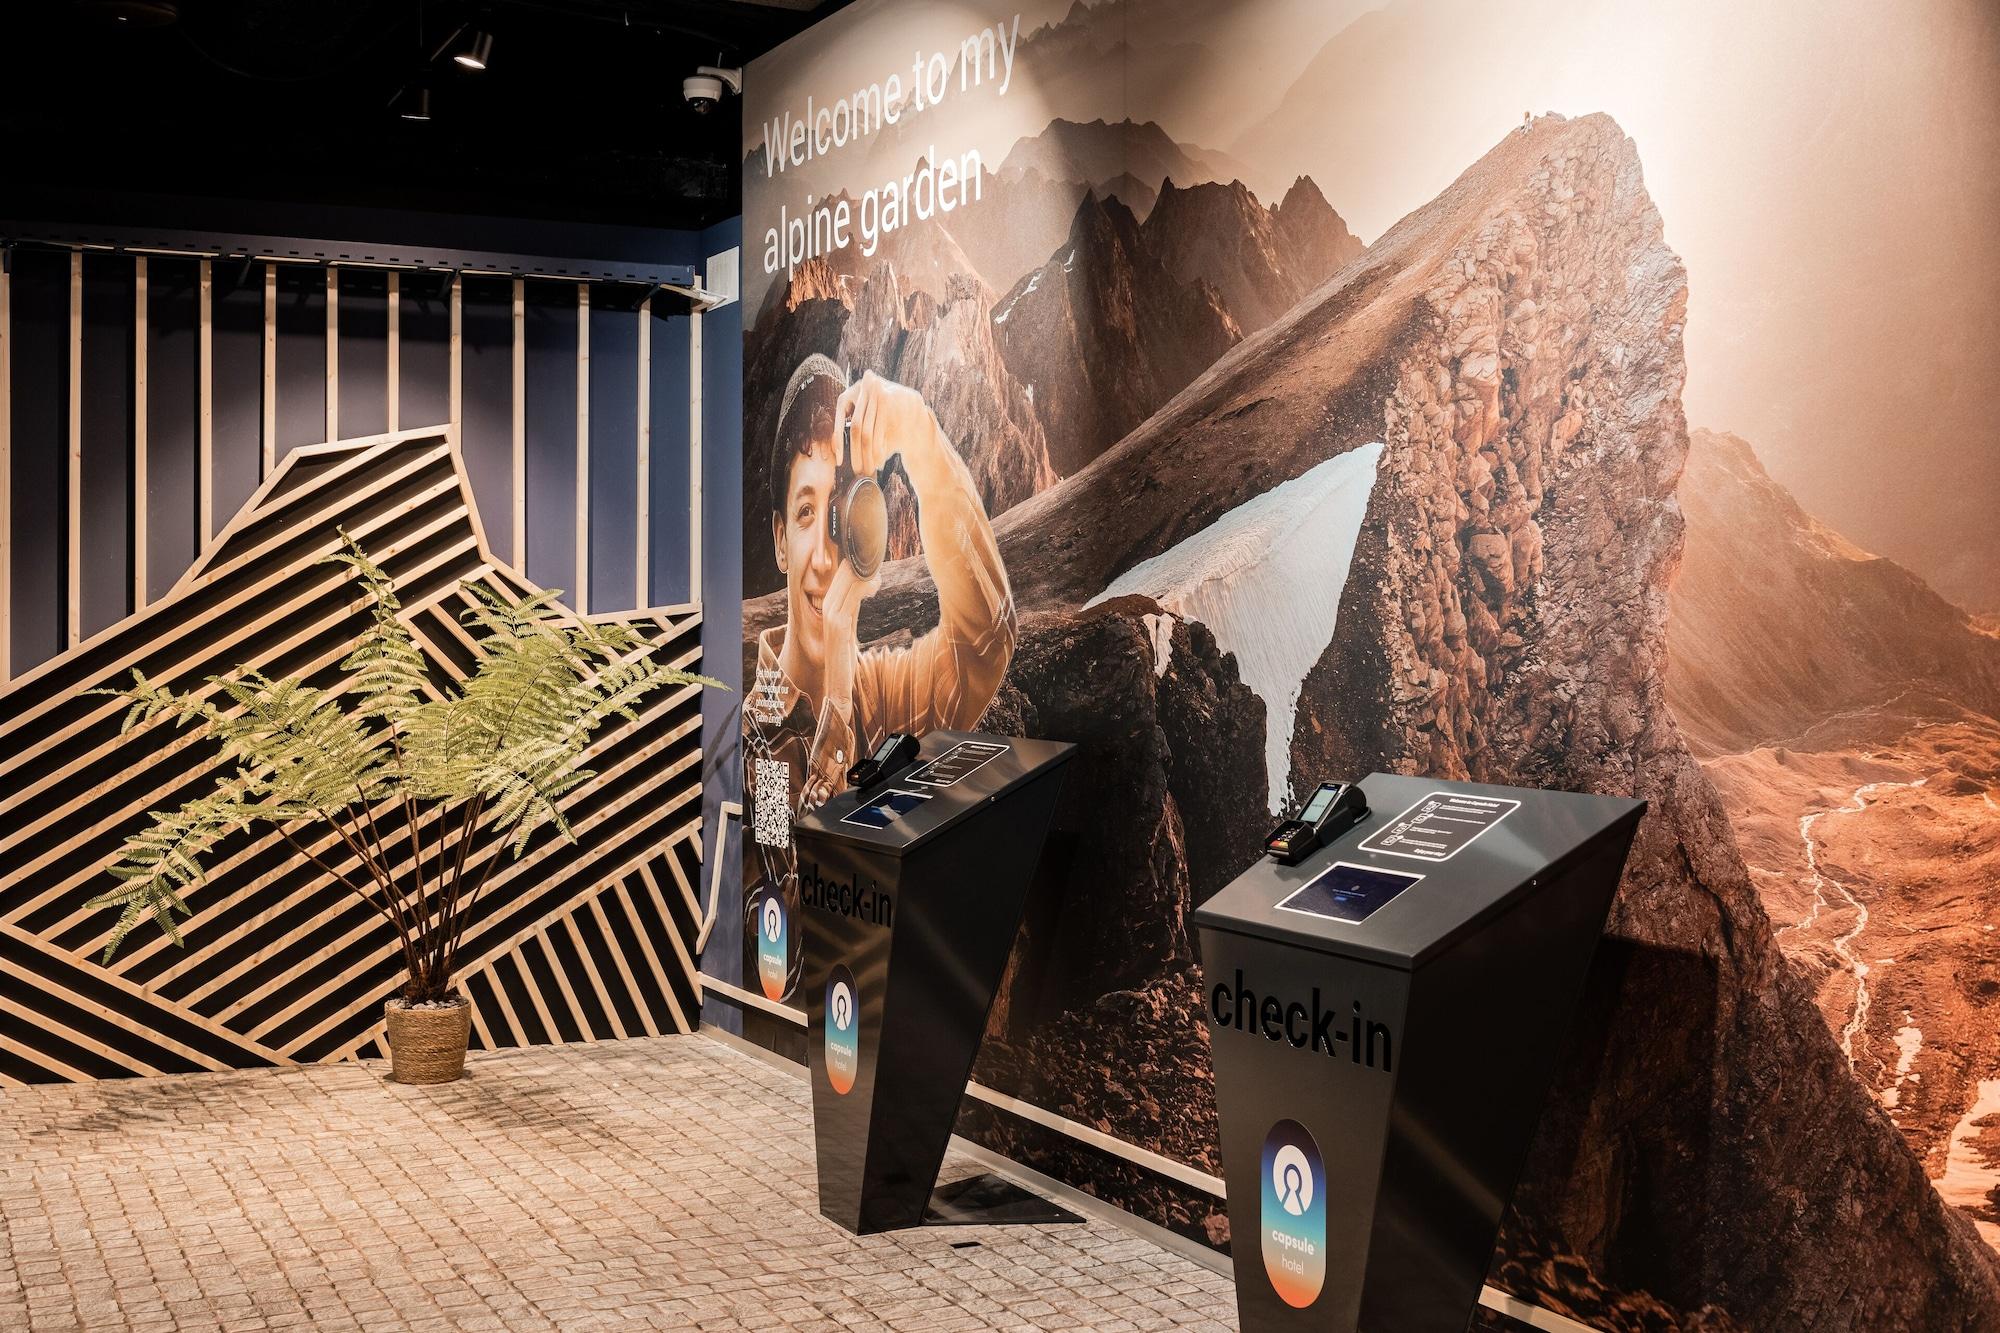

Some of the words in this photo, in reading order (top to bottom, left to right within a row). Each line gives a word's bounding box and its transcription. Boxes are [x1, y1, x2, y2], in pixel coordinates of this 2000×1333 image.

[763, 74, 902, 178] Welcome
[912, 50, 947, 112] to
[960, 14, 1020, 96] my
[763, 194, 851, 282] alpine
[860, 144, 982, 257] garden
[801, 863, 891, 928] check-in
[763, 953, 782, 967] capsule
[1211, 969, 1392, 1073] check-in
[831, 1042, 852, 1057] capsule
[1272, 1229, 1315, 1256] capsule
[1281, 1253, 1304, 1276] hotel
